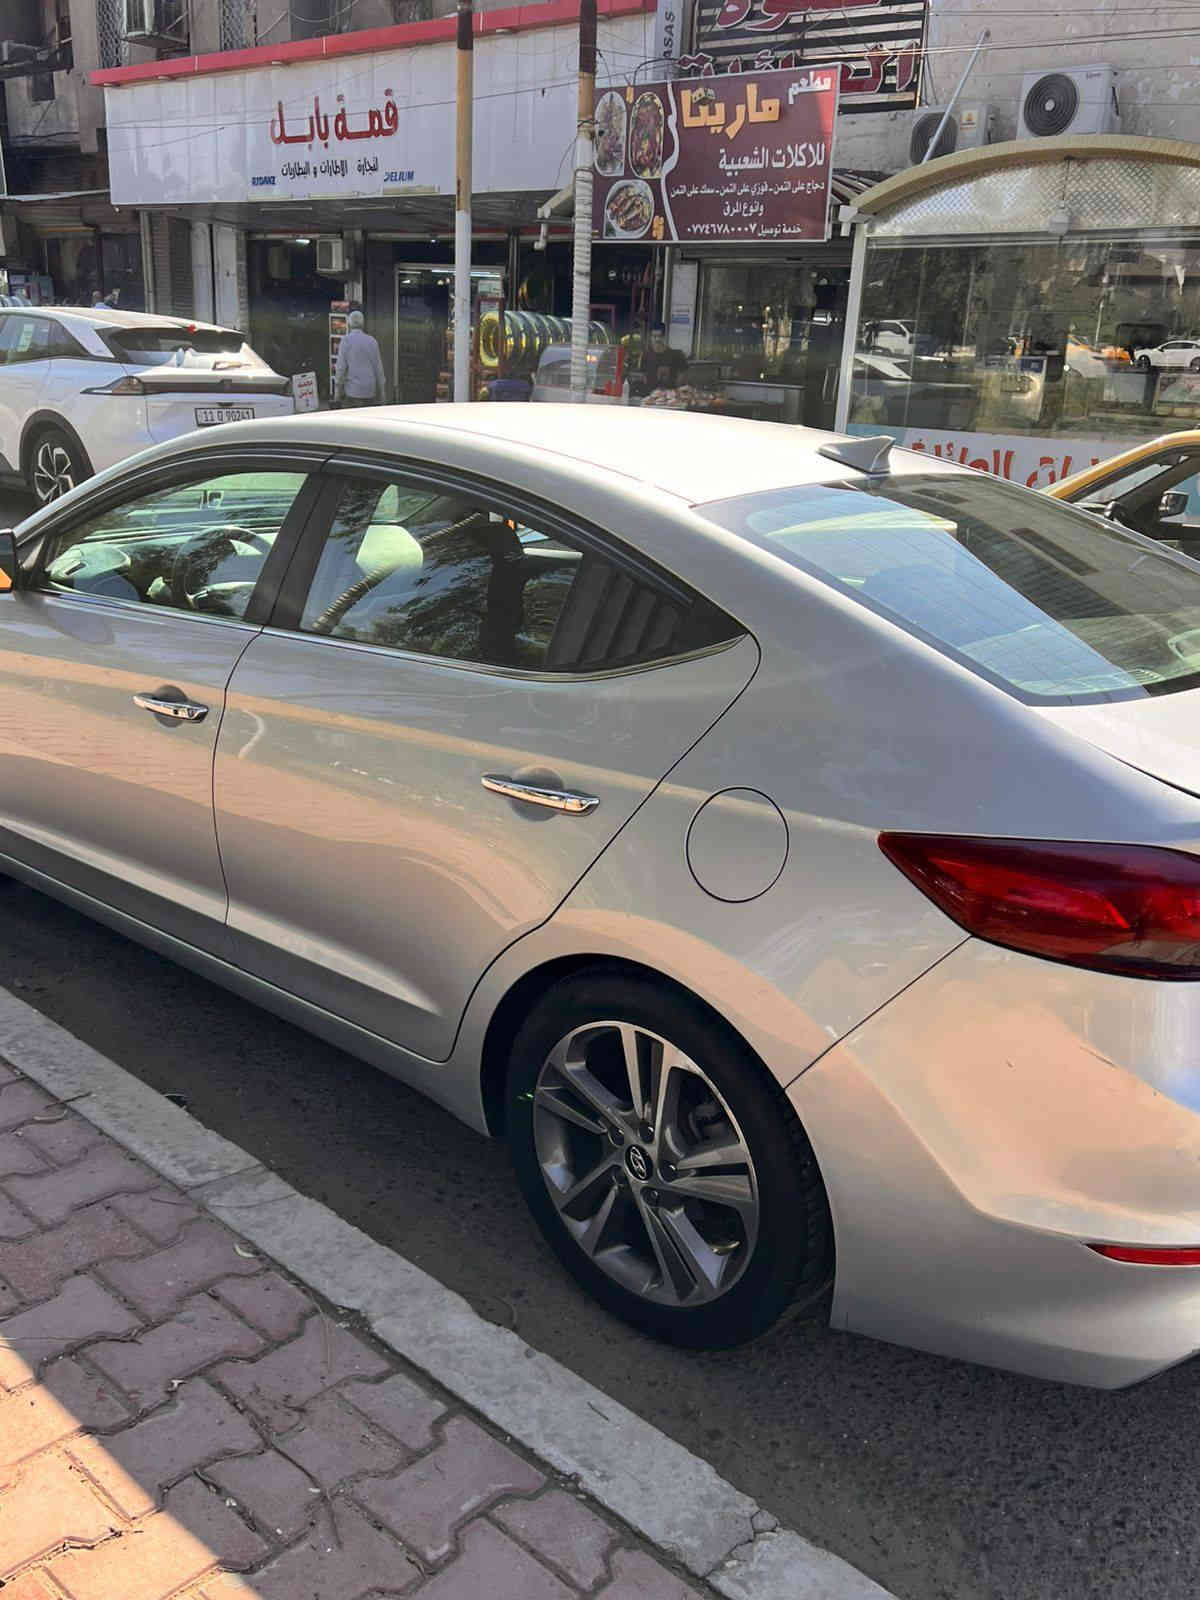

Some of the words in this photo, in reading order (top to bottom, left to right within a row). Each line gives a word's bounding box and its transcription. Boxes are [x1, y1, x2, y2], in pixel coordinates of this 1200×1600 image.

[788, 72, 832, 105] مطعم
[270, 95, 330, 151] بابل
[334, 88, 399, 140] قصة
[719, 146, 769, 177] الشعبية
[772, 142, 825, 168] للاكلات
[774, 181, 791, 195] التمن
[806, 180, 825, 194] دجاج
[723, 200, 742, 216] المرق
[783, 223, 802, 233] خدمة
